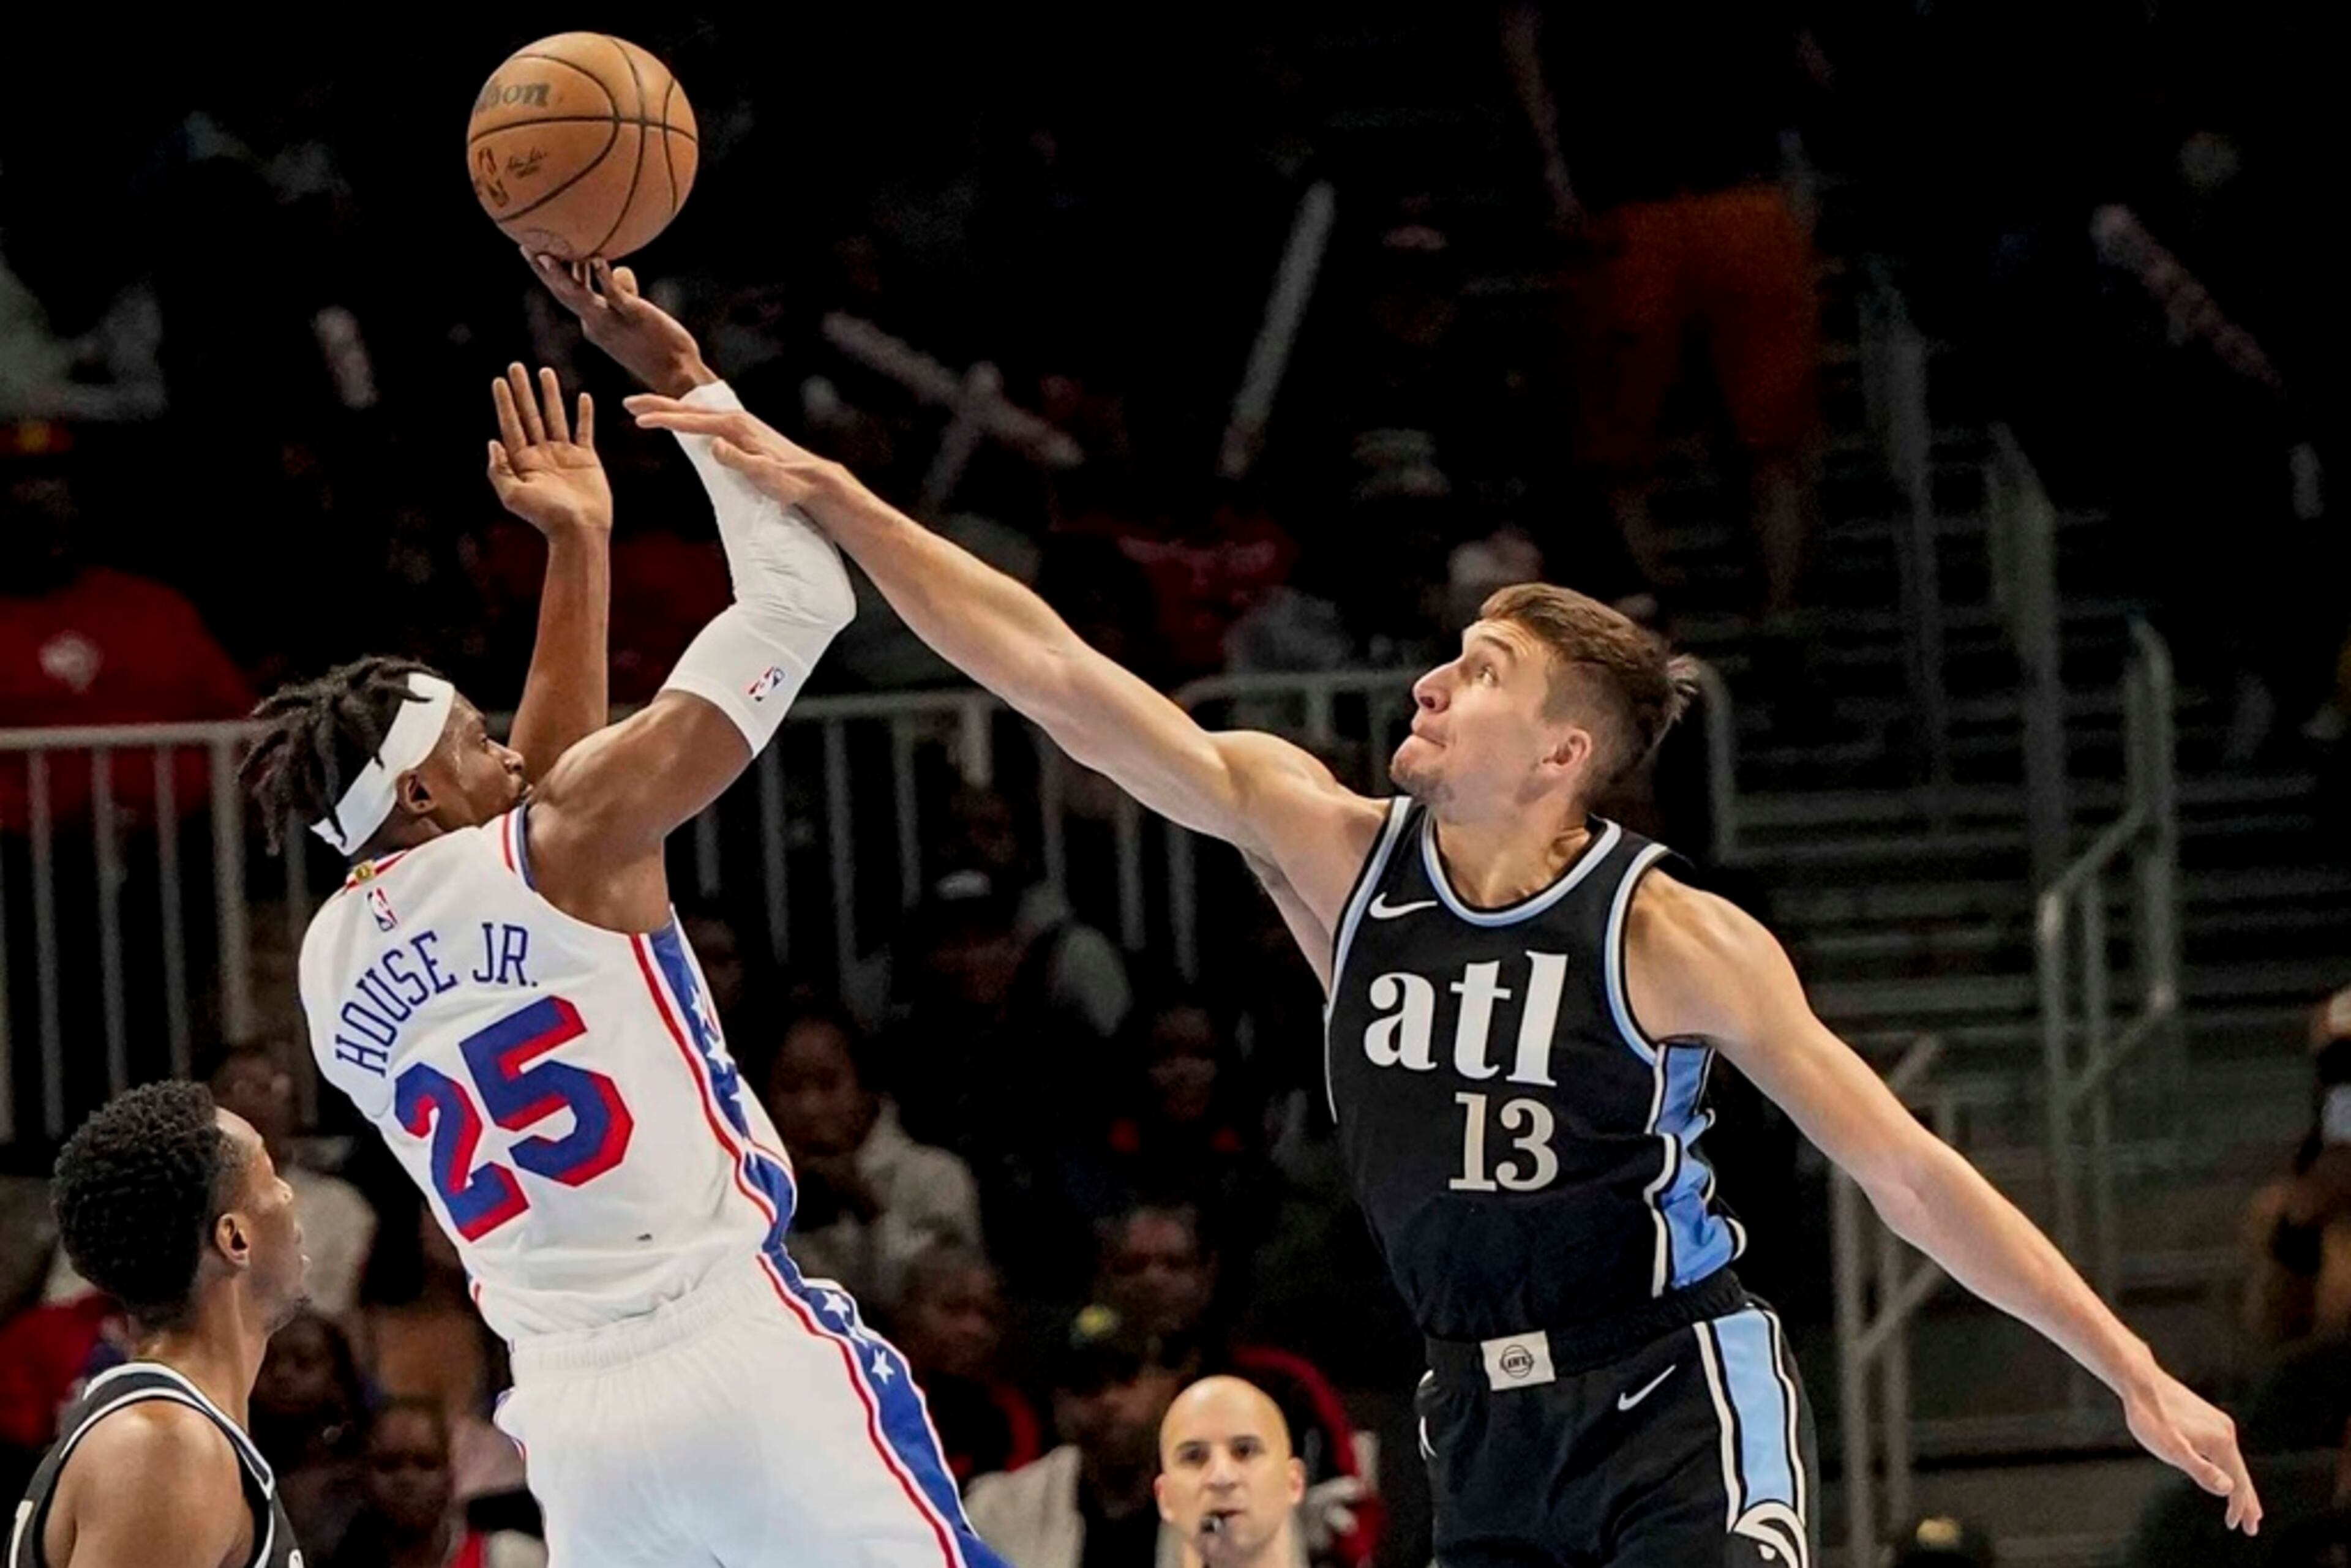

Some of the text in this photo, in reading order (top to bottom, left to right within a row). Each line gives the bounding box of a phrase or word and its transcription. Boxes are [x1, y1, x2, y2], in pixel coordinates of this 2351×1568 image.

[335, 922, 538, 1078] HOUSE JR.
[1363, 950, 1569, 1087] atl
[394, 995, 634, 1243] 25
[1449, 1091, 1559, 1192] 13
